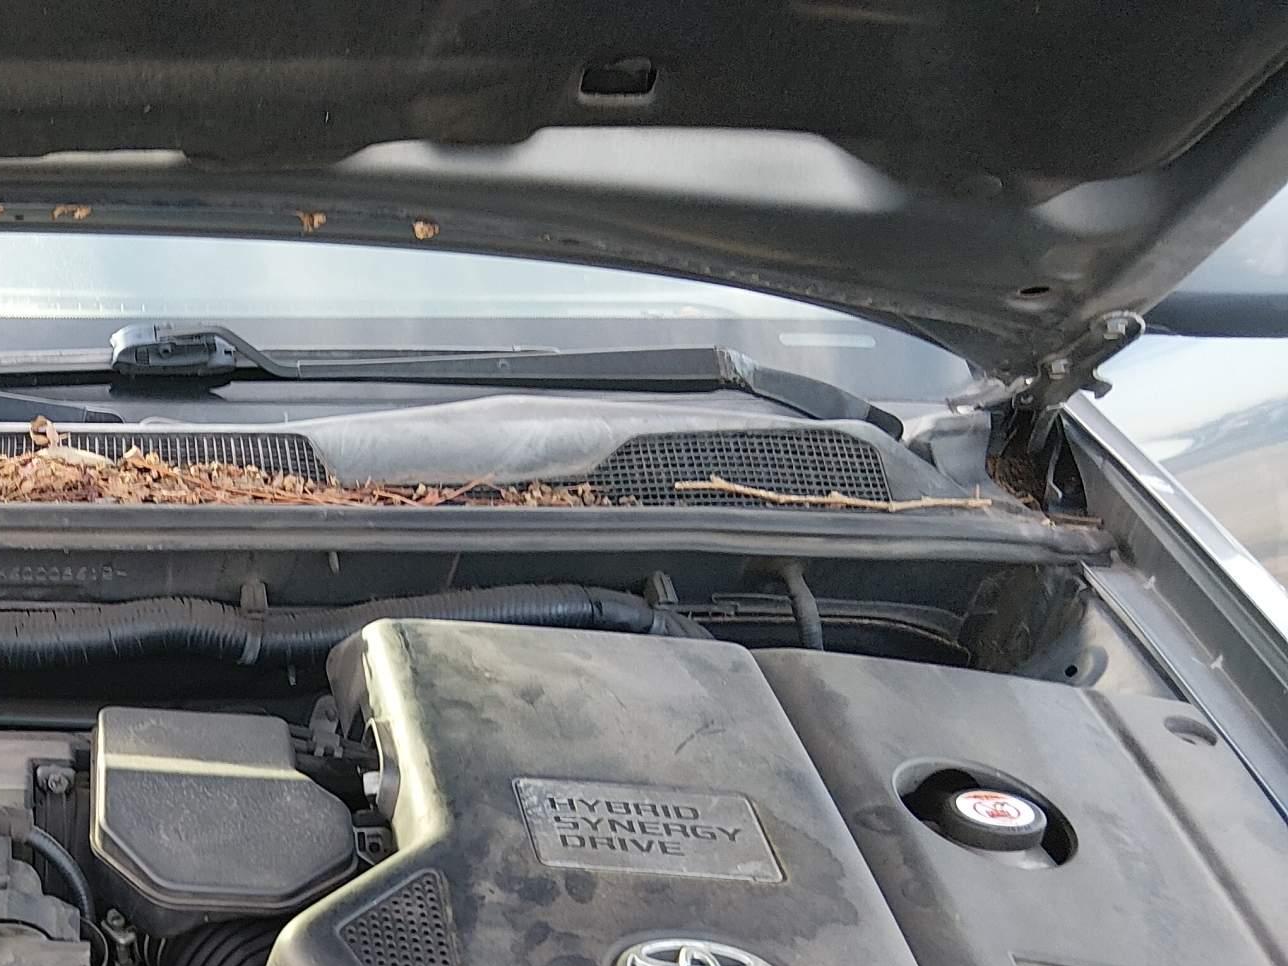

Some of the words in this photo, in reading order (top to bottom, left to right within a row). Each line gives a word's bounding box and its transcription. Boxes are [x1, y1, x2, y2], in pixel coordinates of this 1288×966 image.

[548, 797, 700, 820] HYBRID
[554, 815, 743, 843] SYNERGY
[560, 834, 686, 857] DRIVE
